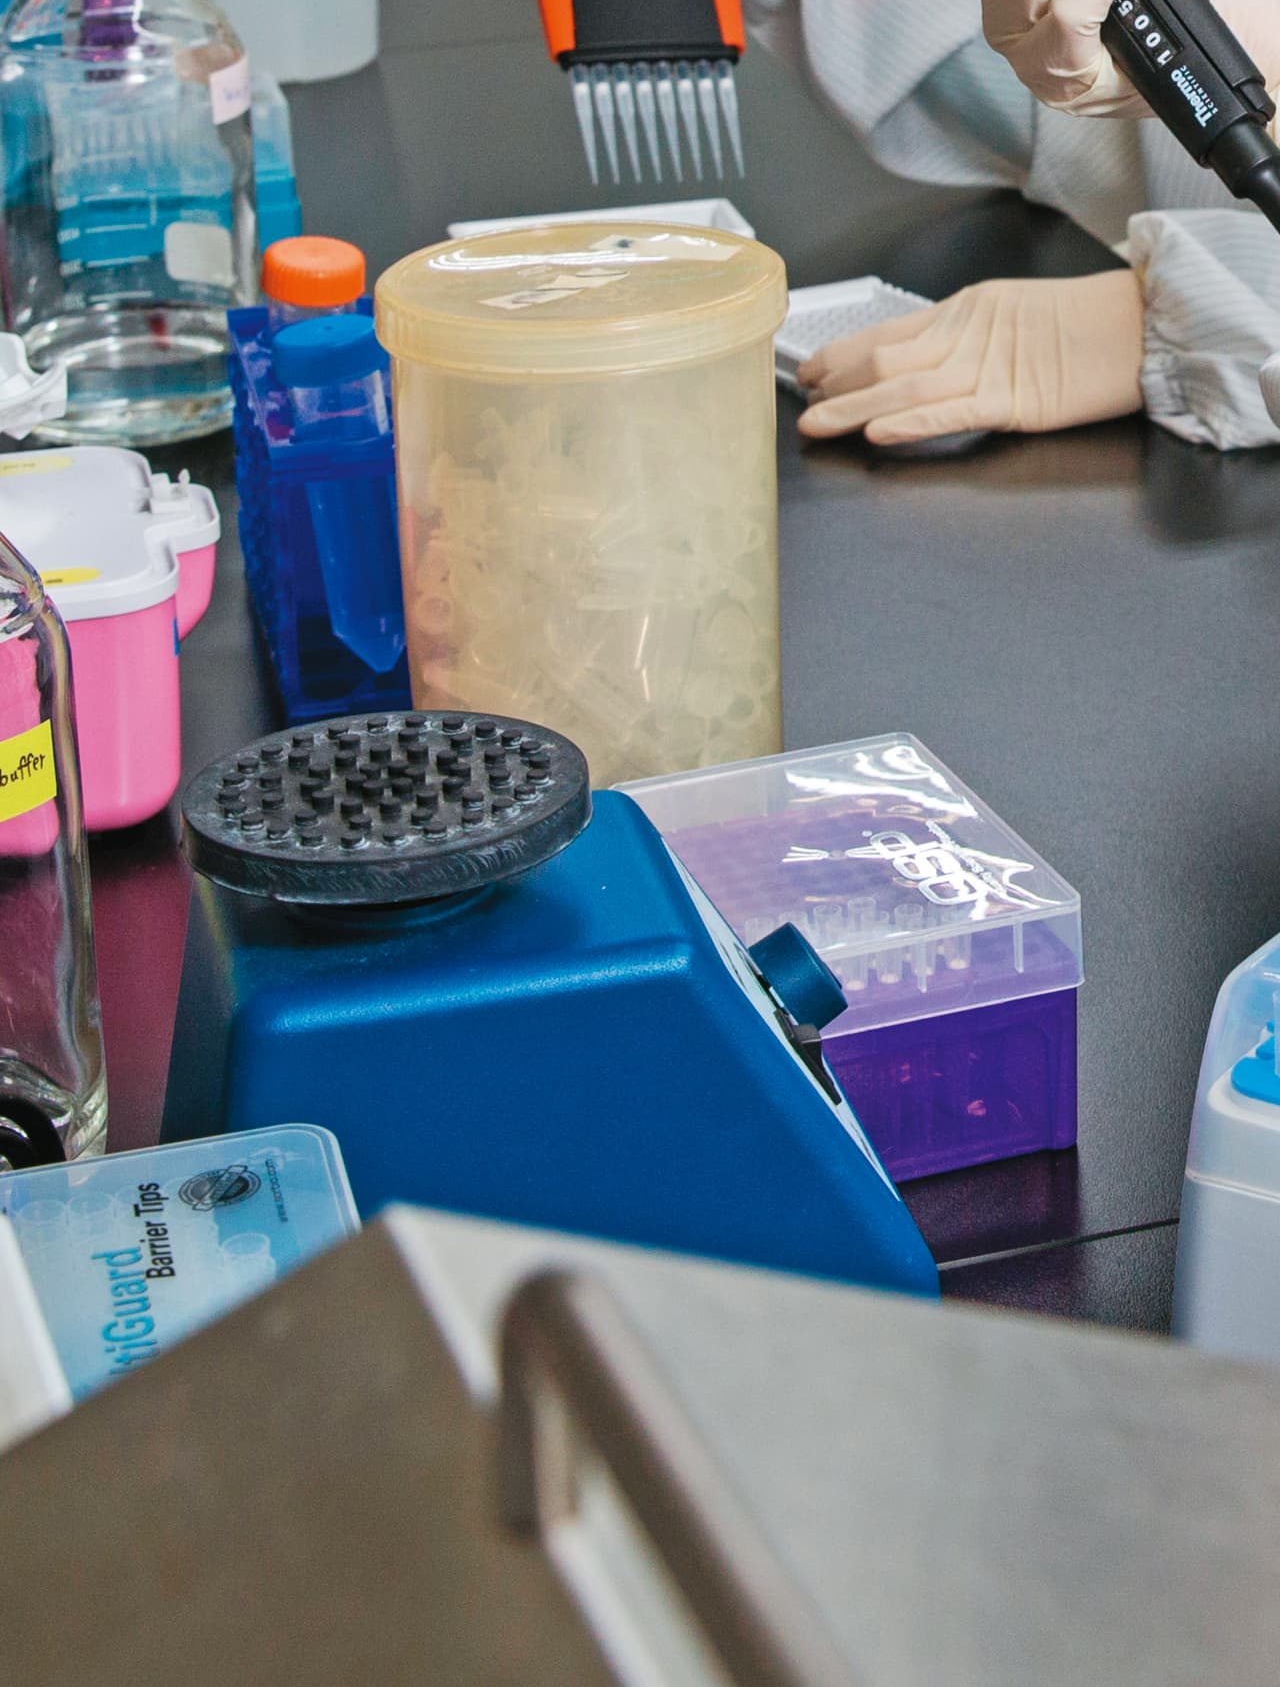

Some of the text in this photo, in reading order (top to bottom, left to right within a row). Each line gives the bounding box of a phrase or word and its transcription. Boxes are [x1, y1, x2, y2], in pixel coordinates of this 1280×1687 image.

[1170, 69, 1213, 128] Thermo
[1178, 64, 1219, 115] SCIENTIFIC
[0, 751, 46, 788] buffer
[133, 1181, 177, 1280] Barrier Tips
